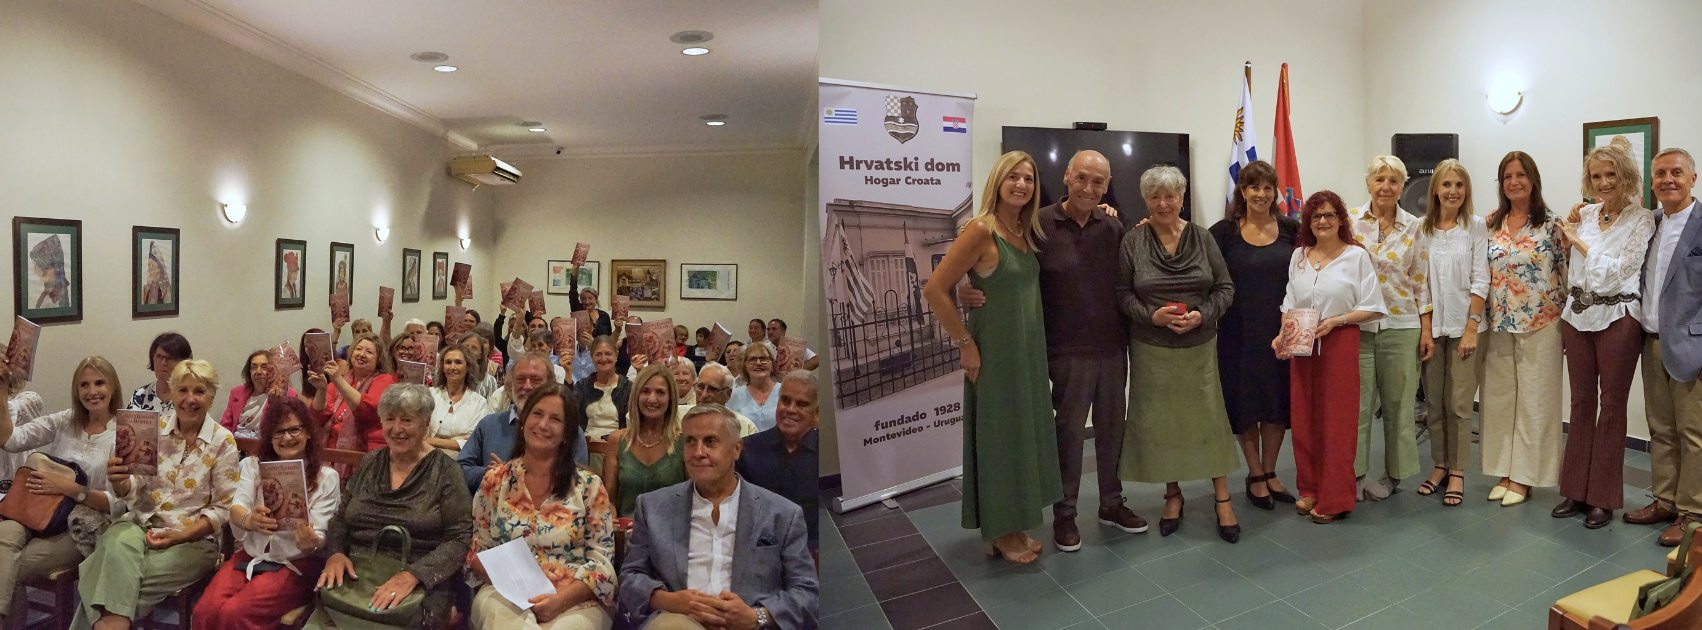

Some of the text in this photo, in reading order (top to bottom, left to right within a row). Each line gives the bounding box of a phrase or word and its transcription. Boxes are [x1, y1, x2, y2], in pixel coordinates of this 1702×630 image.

[839, 155, 961, 172] Hrvatski dom
[864, 175, 942, 187] Hogar Croata
[874, 402, 961, 431] fundado 1928
[863, 425, 924, 447] Montevideo
[933, 415, 963, 428] Urugu
